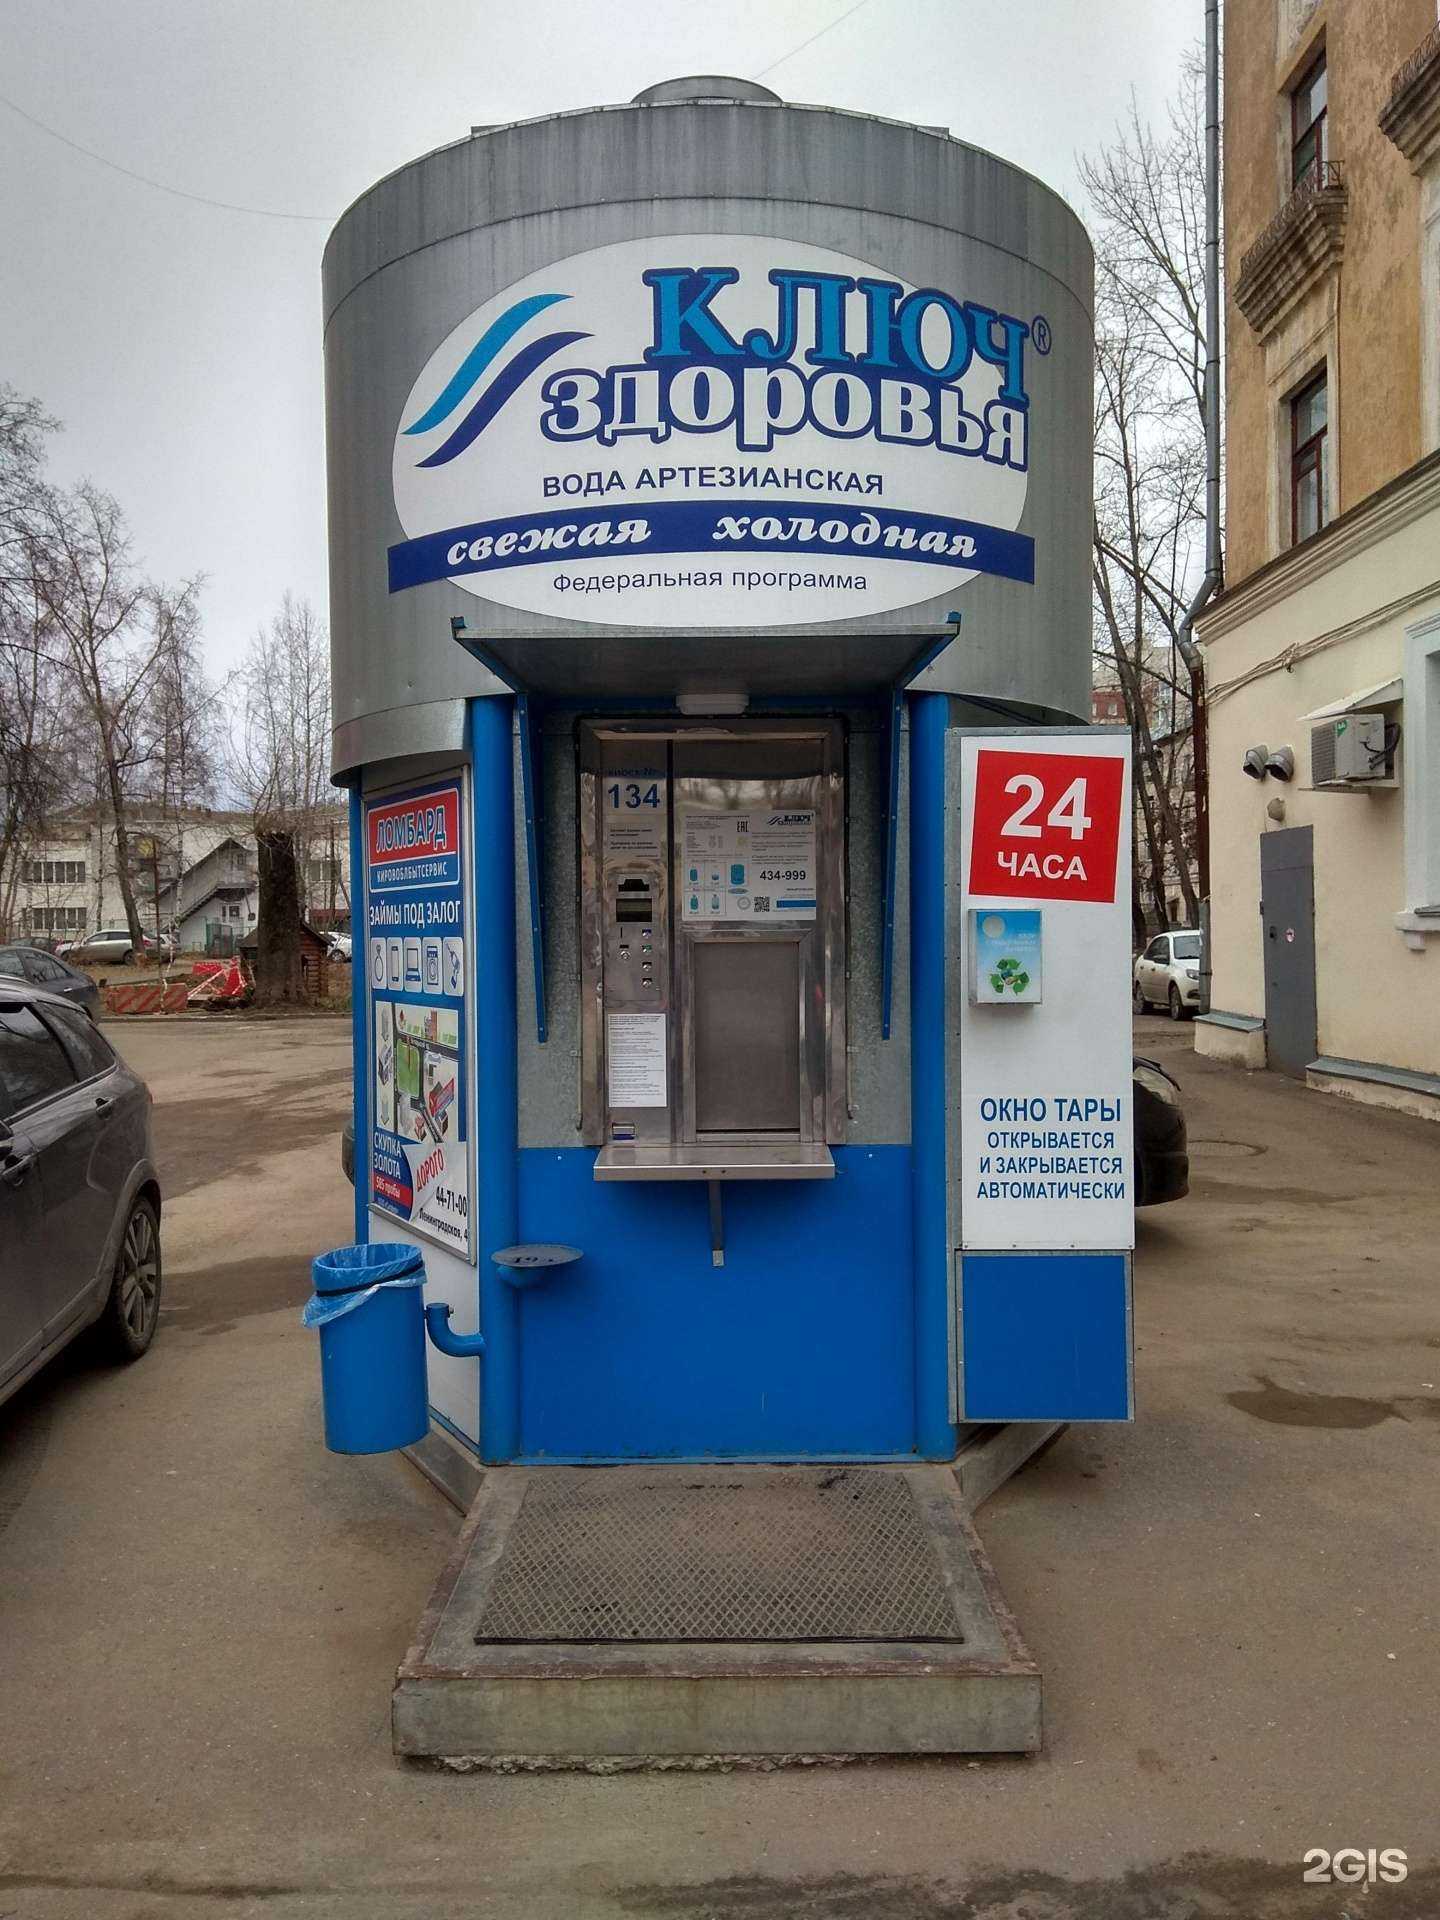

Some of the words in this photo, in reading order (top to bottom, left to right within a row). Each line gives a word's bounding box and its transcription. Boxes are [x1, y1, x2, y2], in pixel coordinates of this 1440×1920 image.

[642, 267, 1031, 402] КЛЮЧ
[543, 470, 626, 497] ВОДА
[636, 466, 883, 495] АРТЕЗИАНСКАЯ
[447, 519, 651, 565] свежая
[712, 512, 977, 558] холодная
[553, 571, 723, 593] Федеральная
[732, 571, 867, 591] программа
[608, 783, 661, 809] 134
[1000, 774, 1092, 841] 24
[376, 805, 447, 854] ЛОМБАРД
[377, 861, 448, 883] КИРОВОБЛБЫТСЕРВИС
[759, 870, 807, 881] 434-999
[997, 851, 1088, 881] ЧАСА
[369, 899, 401, 926] ЗАЙМЫ
[403, 902, 425, 929] ПОД
[426, 900, 461, 925] ЗАЛОГ
[980, 1097, 1047, 1122] ОКНО
[1054, 1098, 1121, 1122] ТАРЫ
[374, 1131, 402, 1158] СКУПКА
[987, 1131, 1115, 1149] ОТКРЫВАЕТСЯ
[373, 1151, 401, 1180] ЗОЛОТА
[416, 1148, 445, 1193] ДОРОГО
[980, 1157, 991, 1174] И
[995, 1157, 1123, 1174] ЗАКРЫВАЕТСЯ
[435, 1185, 467, 1218] 44-71-00
[977, 1182, 1125, 1199] АВТОМАТИЧЕСКИ
